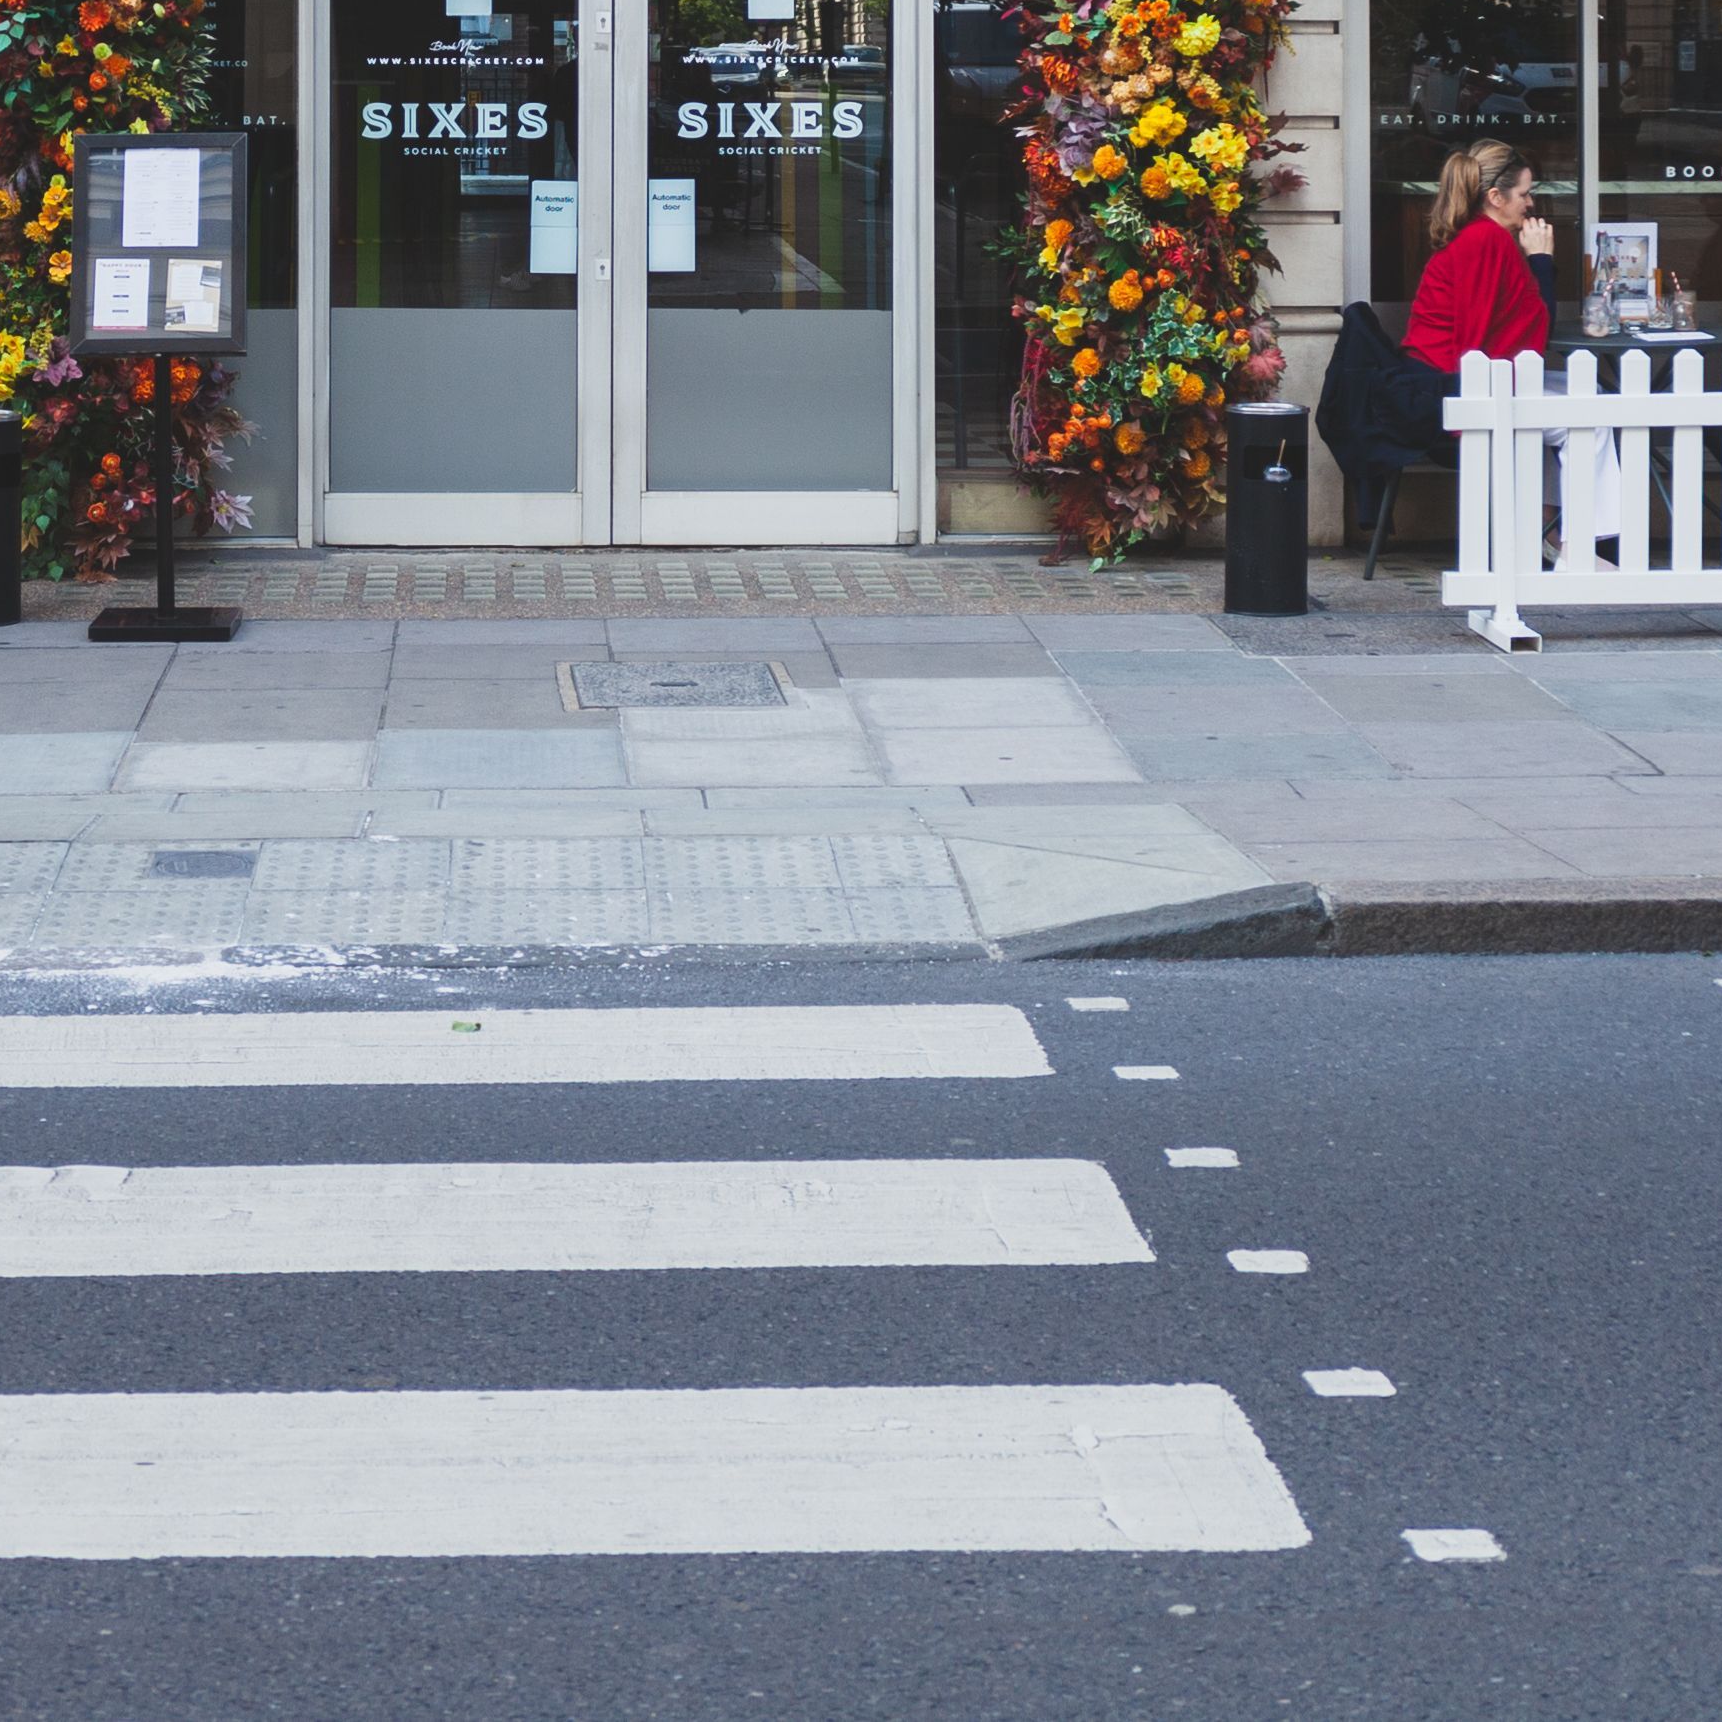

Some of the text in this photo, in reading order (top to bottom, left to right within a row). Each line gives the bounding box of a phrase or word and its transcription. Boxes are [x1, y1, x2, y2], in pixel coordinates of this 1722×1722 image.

[243, 115, 286, 126] BAT.
[361, 102, 548, 139] SIXES
[677, 101, 864, 139] SIXES
[1380, 113, 1566, 125] EAT. DRINK. BAT.
[403, 147, 508, 156] SOCIAL CRICKET
[718, 146, 823, 155] SOCIAL CRICKET
[535, 195, 575, 204] Automatic
[652, 193, 692, 202] Automatic
[662, 203, 681, 211] door
